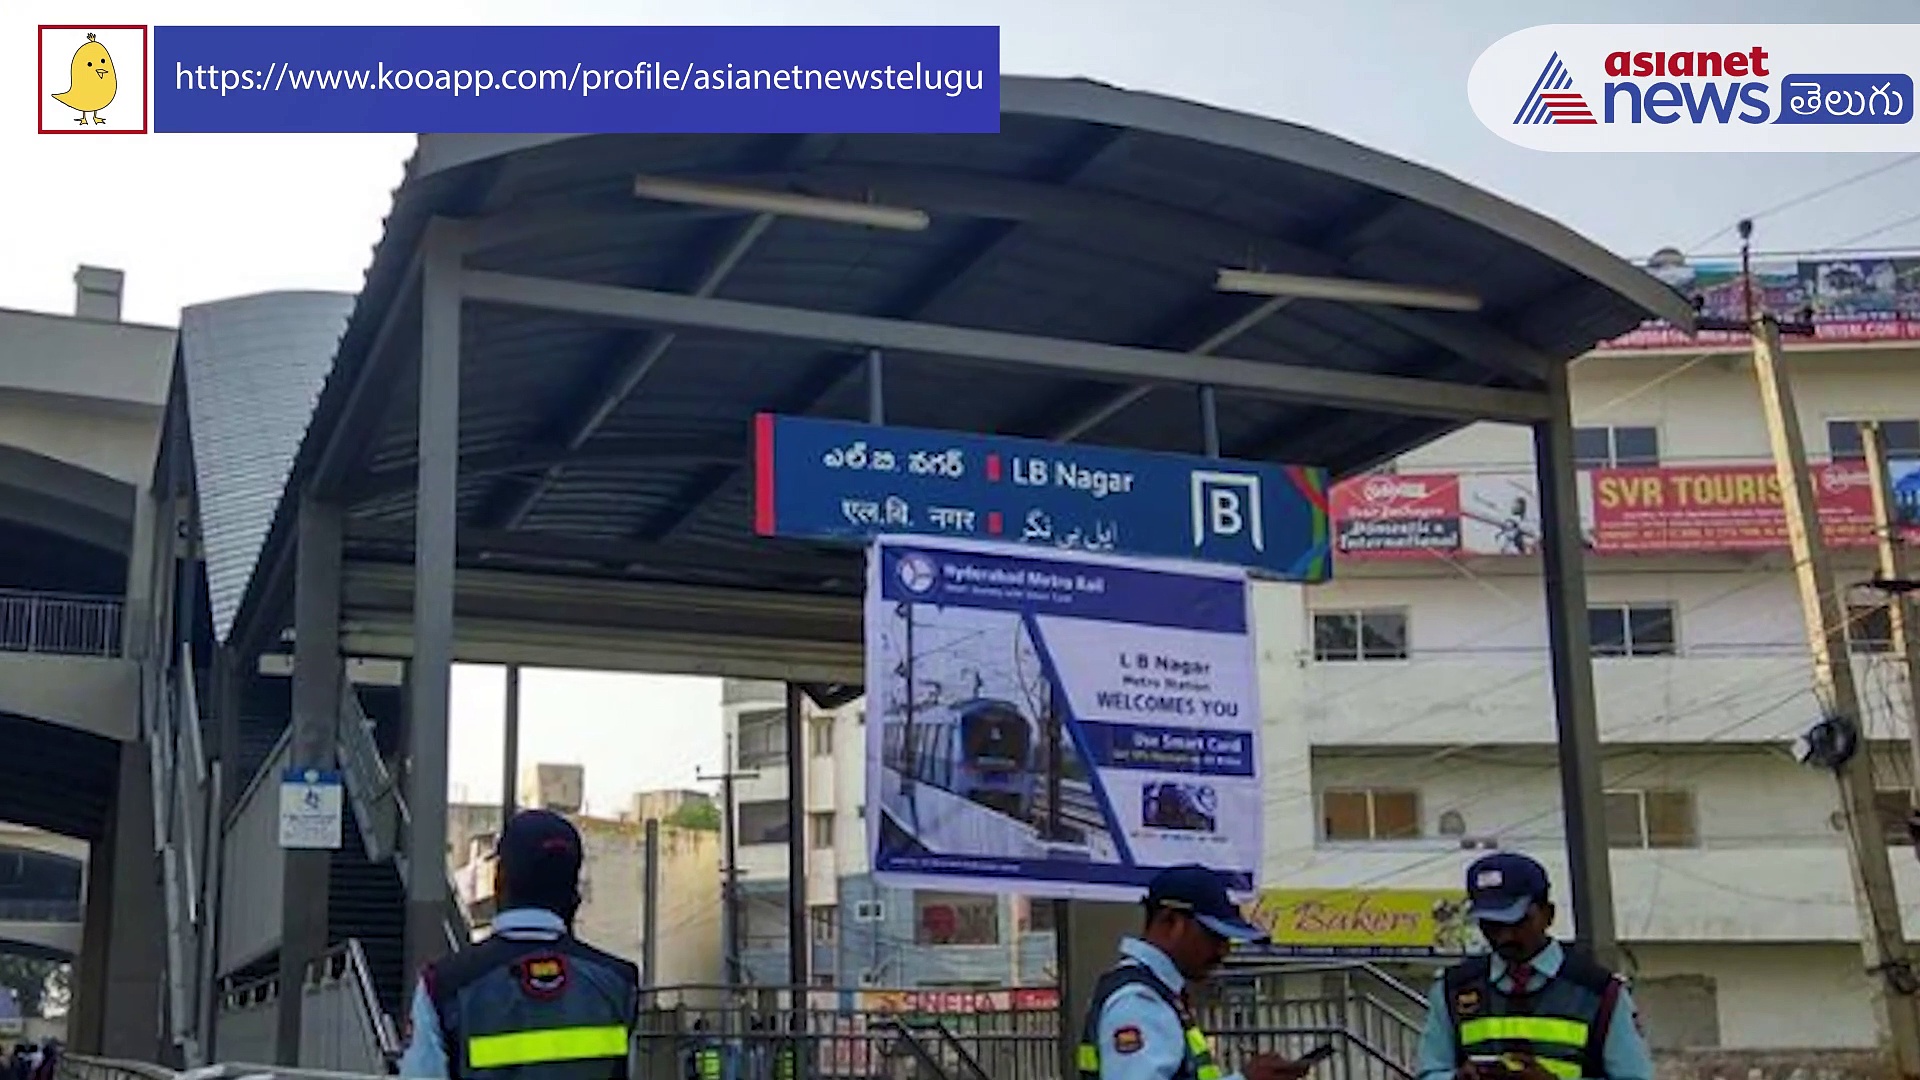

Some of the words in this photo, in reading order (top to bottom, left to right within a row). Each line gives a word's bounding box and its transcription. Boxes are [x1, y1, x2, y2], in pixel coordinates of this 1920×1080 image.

[1012, 457, 1048, 486] LB
[1054, 461, 1134, 498] Nagar
[1600, 476, 1661, 508] SVR
[1670, 473, 1818, 506] TOURIS
[928, 507, 976, 531] नगर
[1211, 489, 1243, 534] B
[943, 563, 1025, 586] Hyderabad
[1027, 571, 1073, 590] Metro
[1119, 652, 1131, 669] L
[1138, 653, 1148, 669] B
[1155, 655, 1211, 675] Nagar
[1123, 675, 1161, 688] Metro
[1096, 691, 1196, 715] WELCOMES
[1202, 700, 1239, 718] YOU
[1161, 733, 1203, 751] Smart
[1206, 737, 1243, 753] Card
